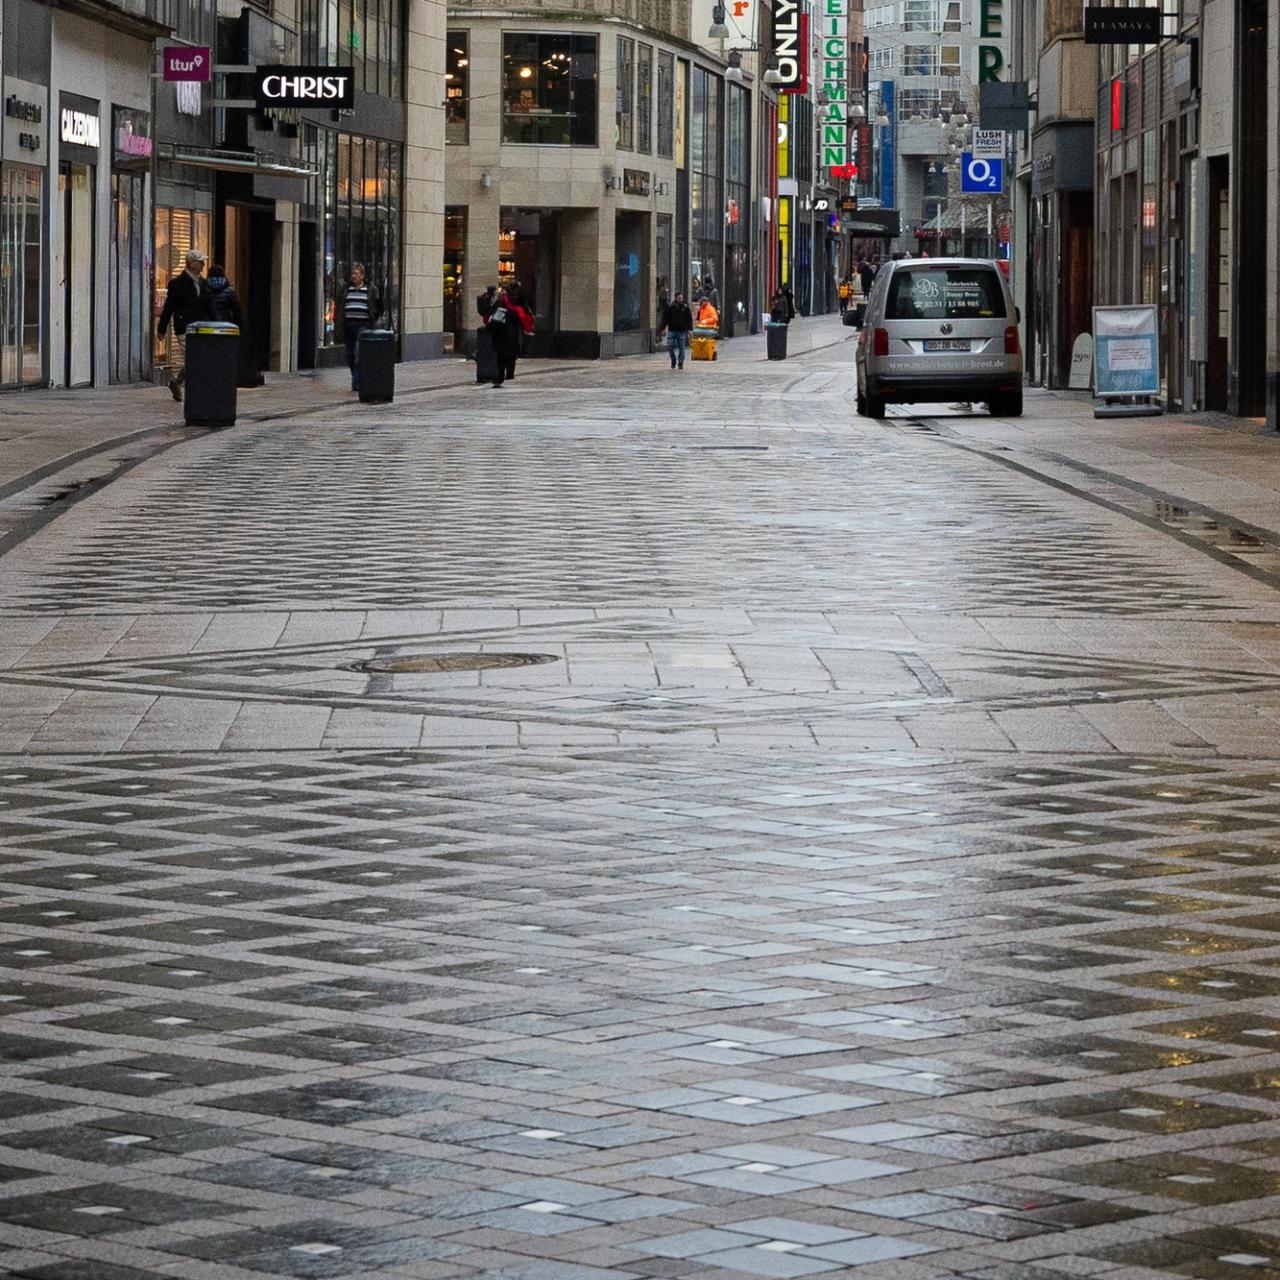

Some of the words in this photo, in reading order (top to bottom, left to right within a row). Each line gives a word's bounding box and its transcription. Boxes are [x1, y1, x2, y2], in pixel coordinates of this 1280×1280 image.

[170, 58, 194, 72] ltur
[262, 75, 348, 98] CHRIST
[815, 200, 828, 210] JD
